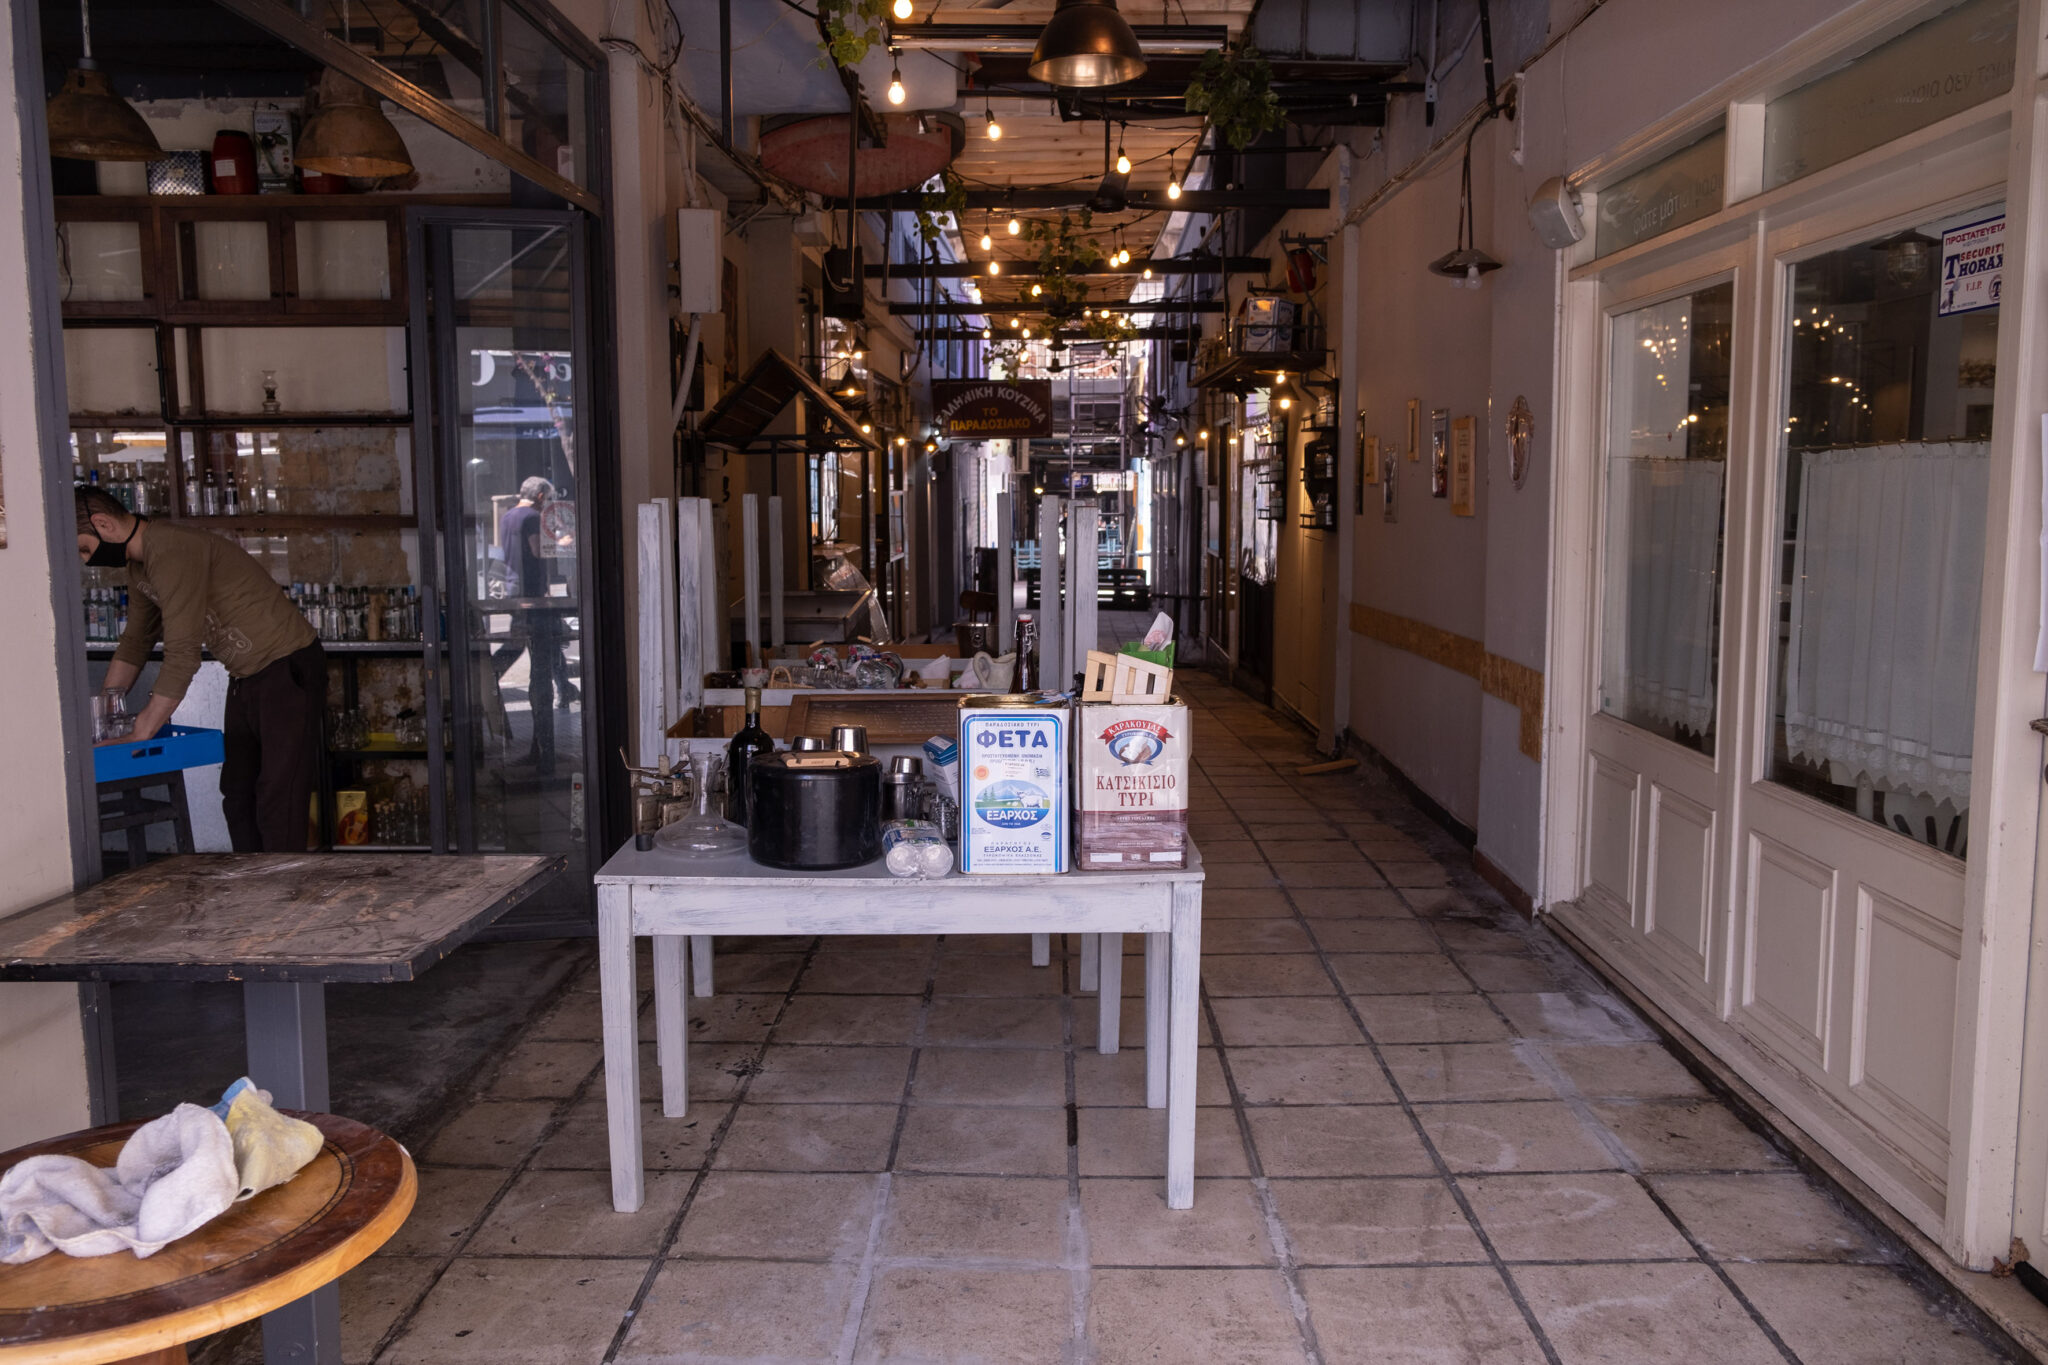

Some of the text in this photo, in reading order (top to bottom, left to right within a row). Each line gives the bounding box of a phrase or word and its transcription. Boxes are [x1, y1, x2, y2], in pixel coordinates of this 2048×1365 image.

[982, 407, 998, 417] ΤΟ
[997, 386, 1046, 424] ΚΟΥΖΙΝΑ
[950, 417, 1031, 431] ΠΑΡΑΔΟΣΙΑΚΟ
[976, 730, 1049, 748] ΦΕΤΑ
[1096, 774, 1176, 790] ΚΑΤΣΙΚΙΣΙΟ
[1118, 791, 1154, 807] ΤΥΡΙ
[986, 810, 1038, 821] ΕΞΑΡΧΟΣ
